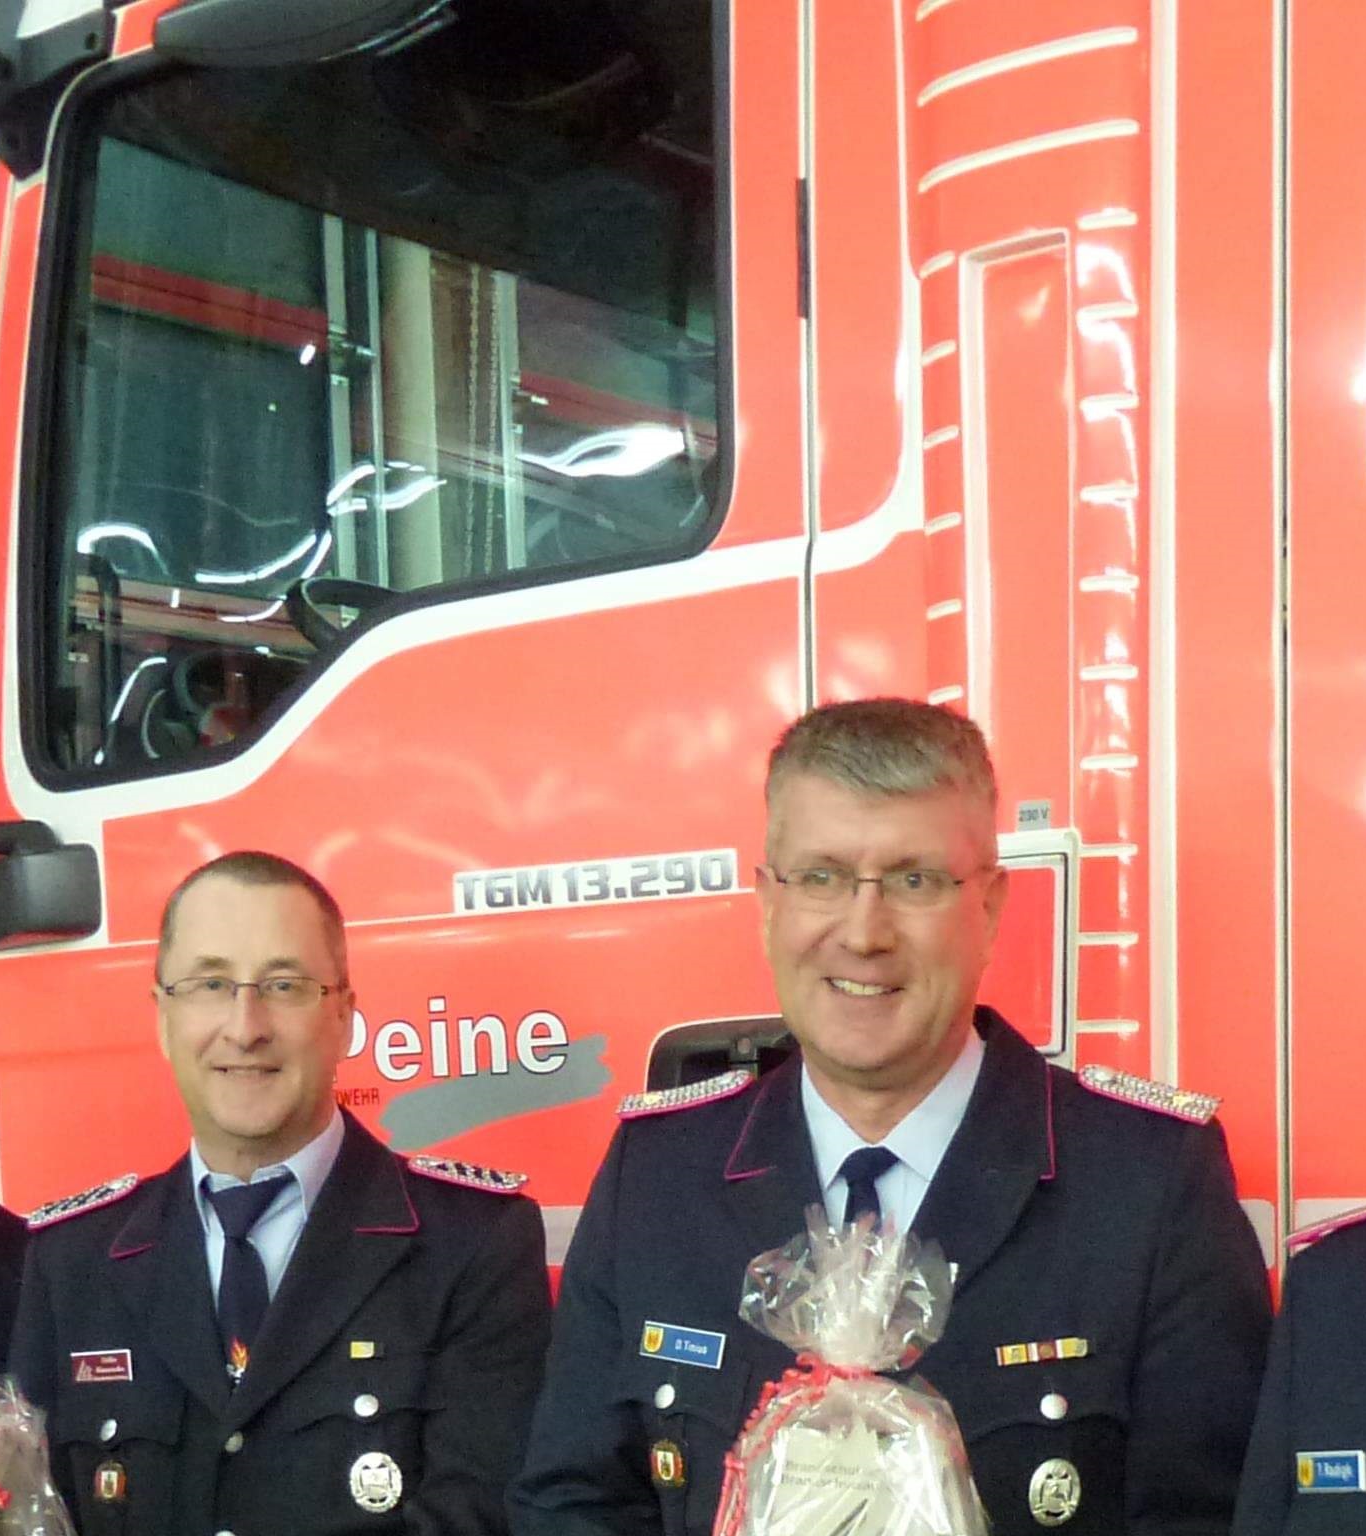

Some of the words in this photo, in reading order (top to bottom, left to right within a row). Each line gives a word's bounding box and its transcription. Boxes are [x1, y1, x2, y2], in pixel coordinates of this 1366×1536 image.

[456, 868, 552, 910] TGM
[563, 853, 733, 902] 13.290
[335, 1087, 380, 1106] WEHR
